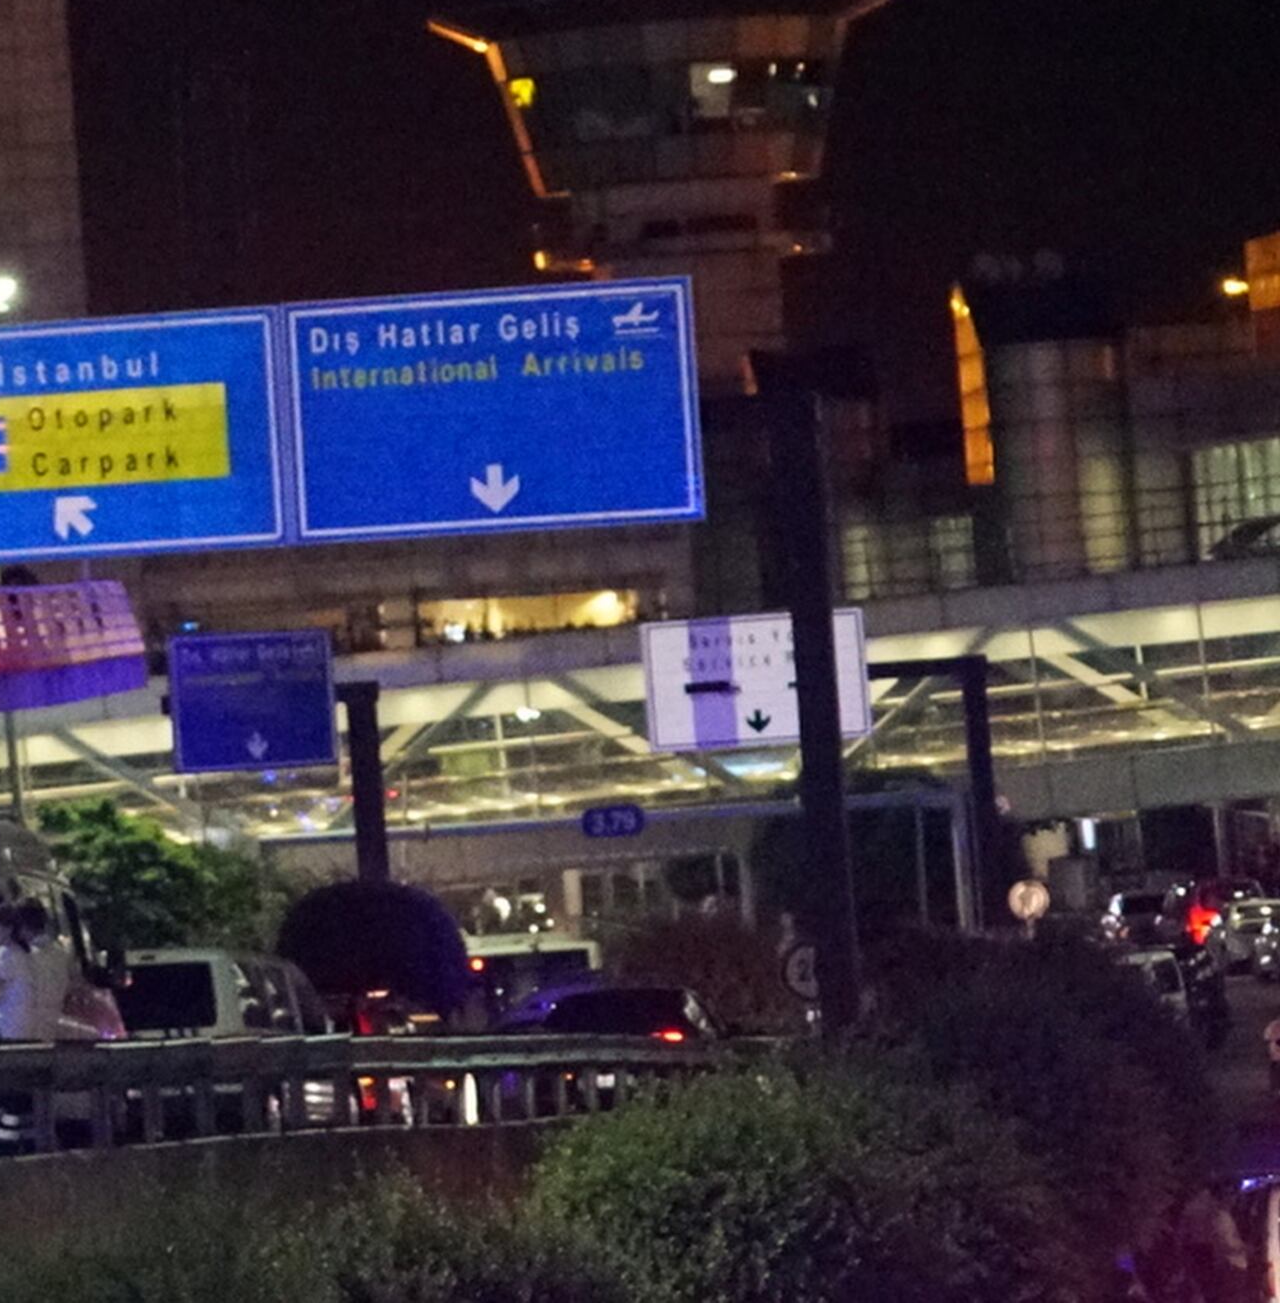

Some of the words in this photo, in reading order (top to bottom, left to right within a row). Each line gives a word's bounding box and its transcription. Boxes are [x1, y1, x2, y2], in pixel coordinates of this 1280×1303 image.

[309, 326, 360, 356] Dış
[377, 319, 481, 349] Hatlar
[497, 311, 582, 342] Geliş
[521, 346, 645, 378] Arrivals
[26, 398, 178, 432] Otopark
[30, 444, 180, 478] Carpark
